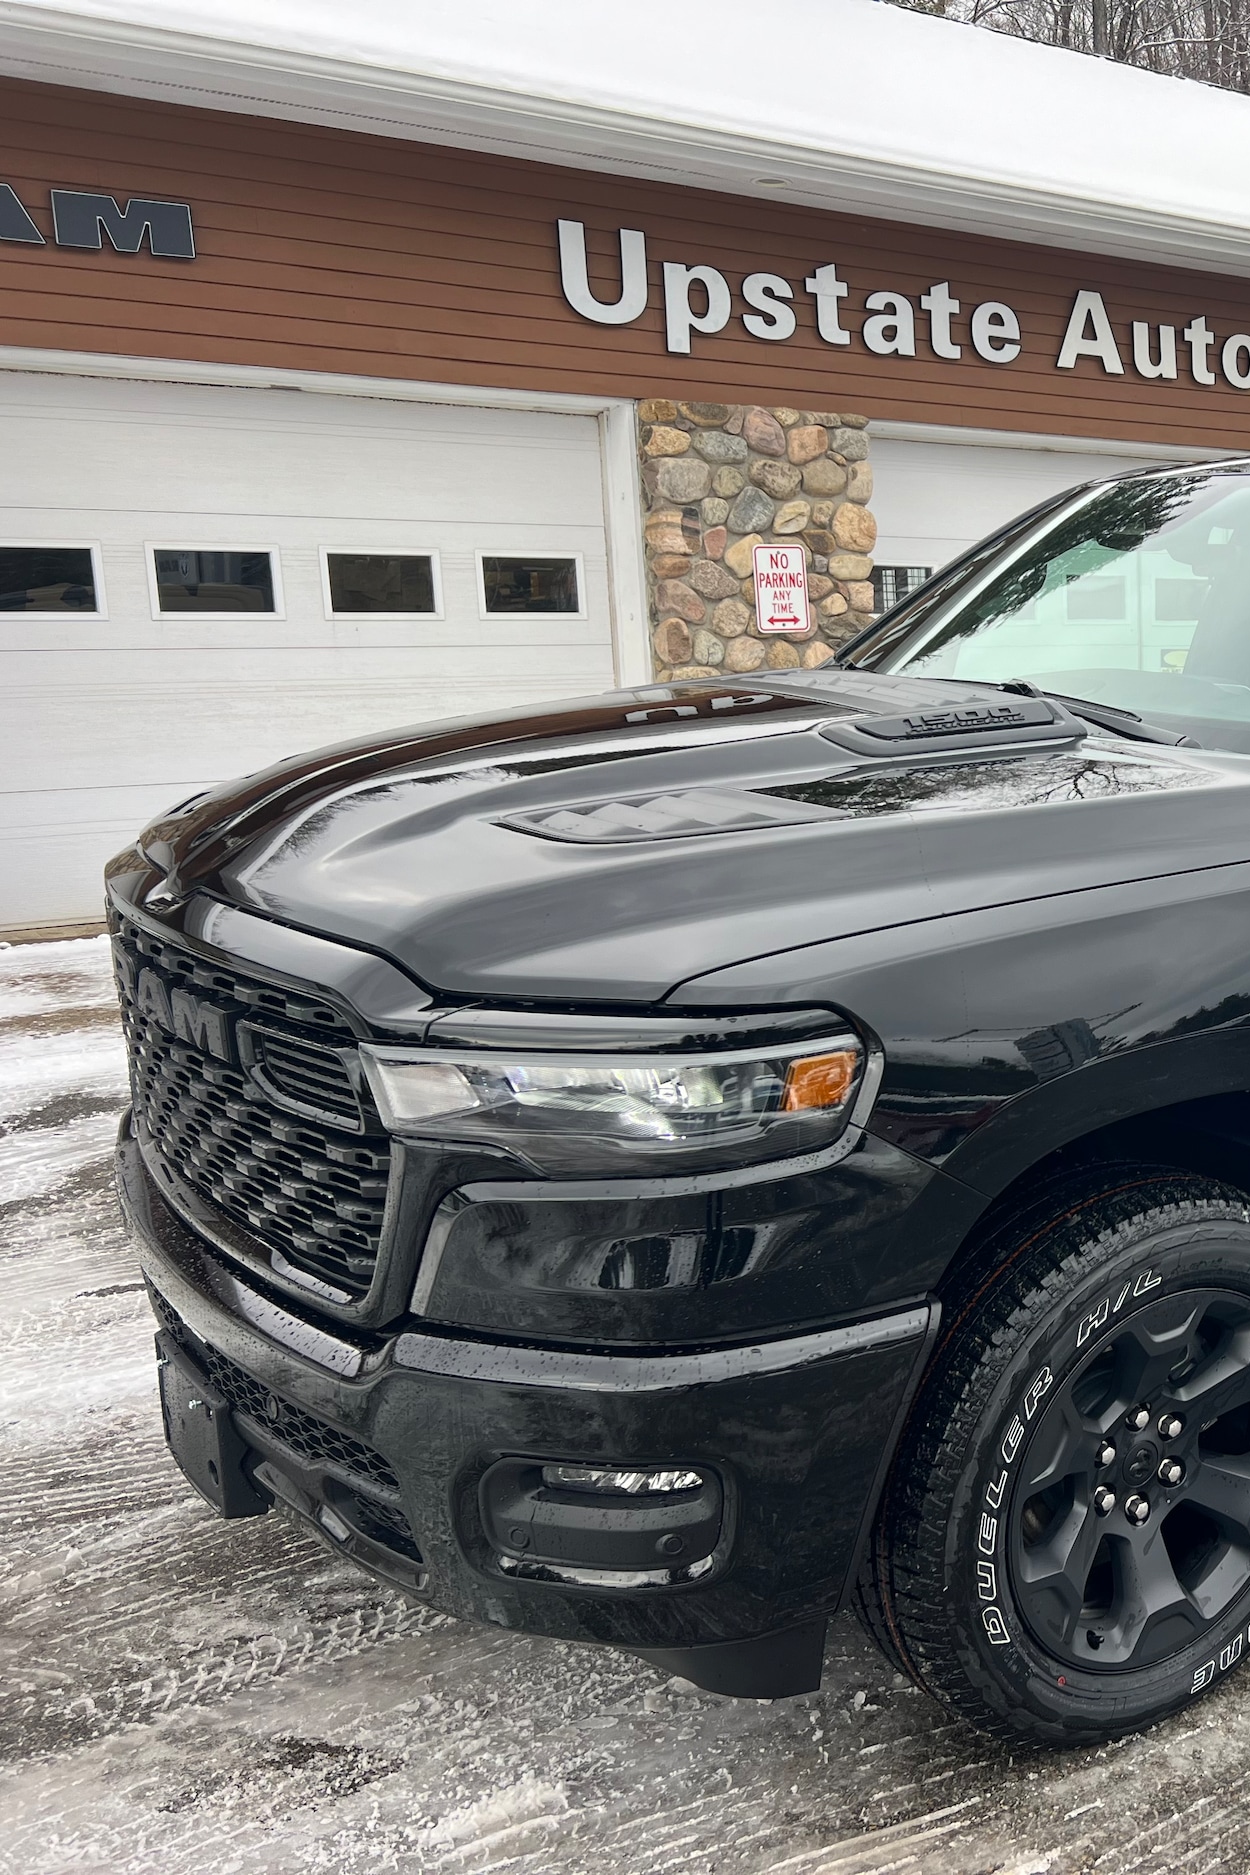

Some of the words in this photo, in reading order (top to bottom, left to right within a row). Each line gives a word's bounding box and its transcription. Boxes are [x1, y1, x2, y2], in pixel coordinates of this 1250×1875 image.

[556, 218, 1022, 364] Upstate
[770, 553, 789, 570] NO
[759, 572, 803, 589] PARKING
[773, 590, 792, 601] ANY
[772, 602, 795, 614] TIME
[903, 705, 1021, 730] 1500
[111, 934, 232, 1064] RAM
[976, 1365, 1054, 1645] DUELER
[1077, 1269, 1162, 1347] H/L
